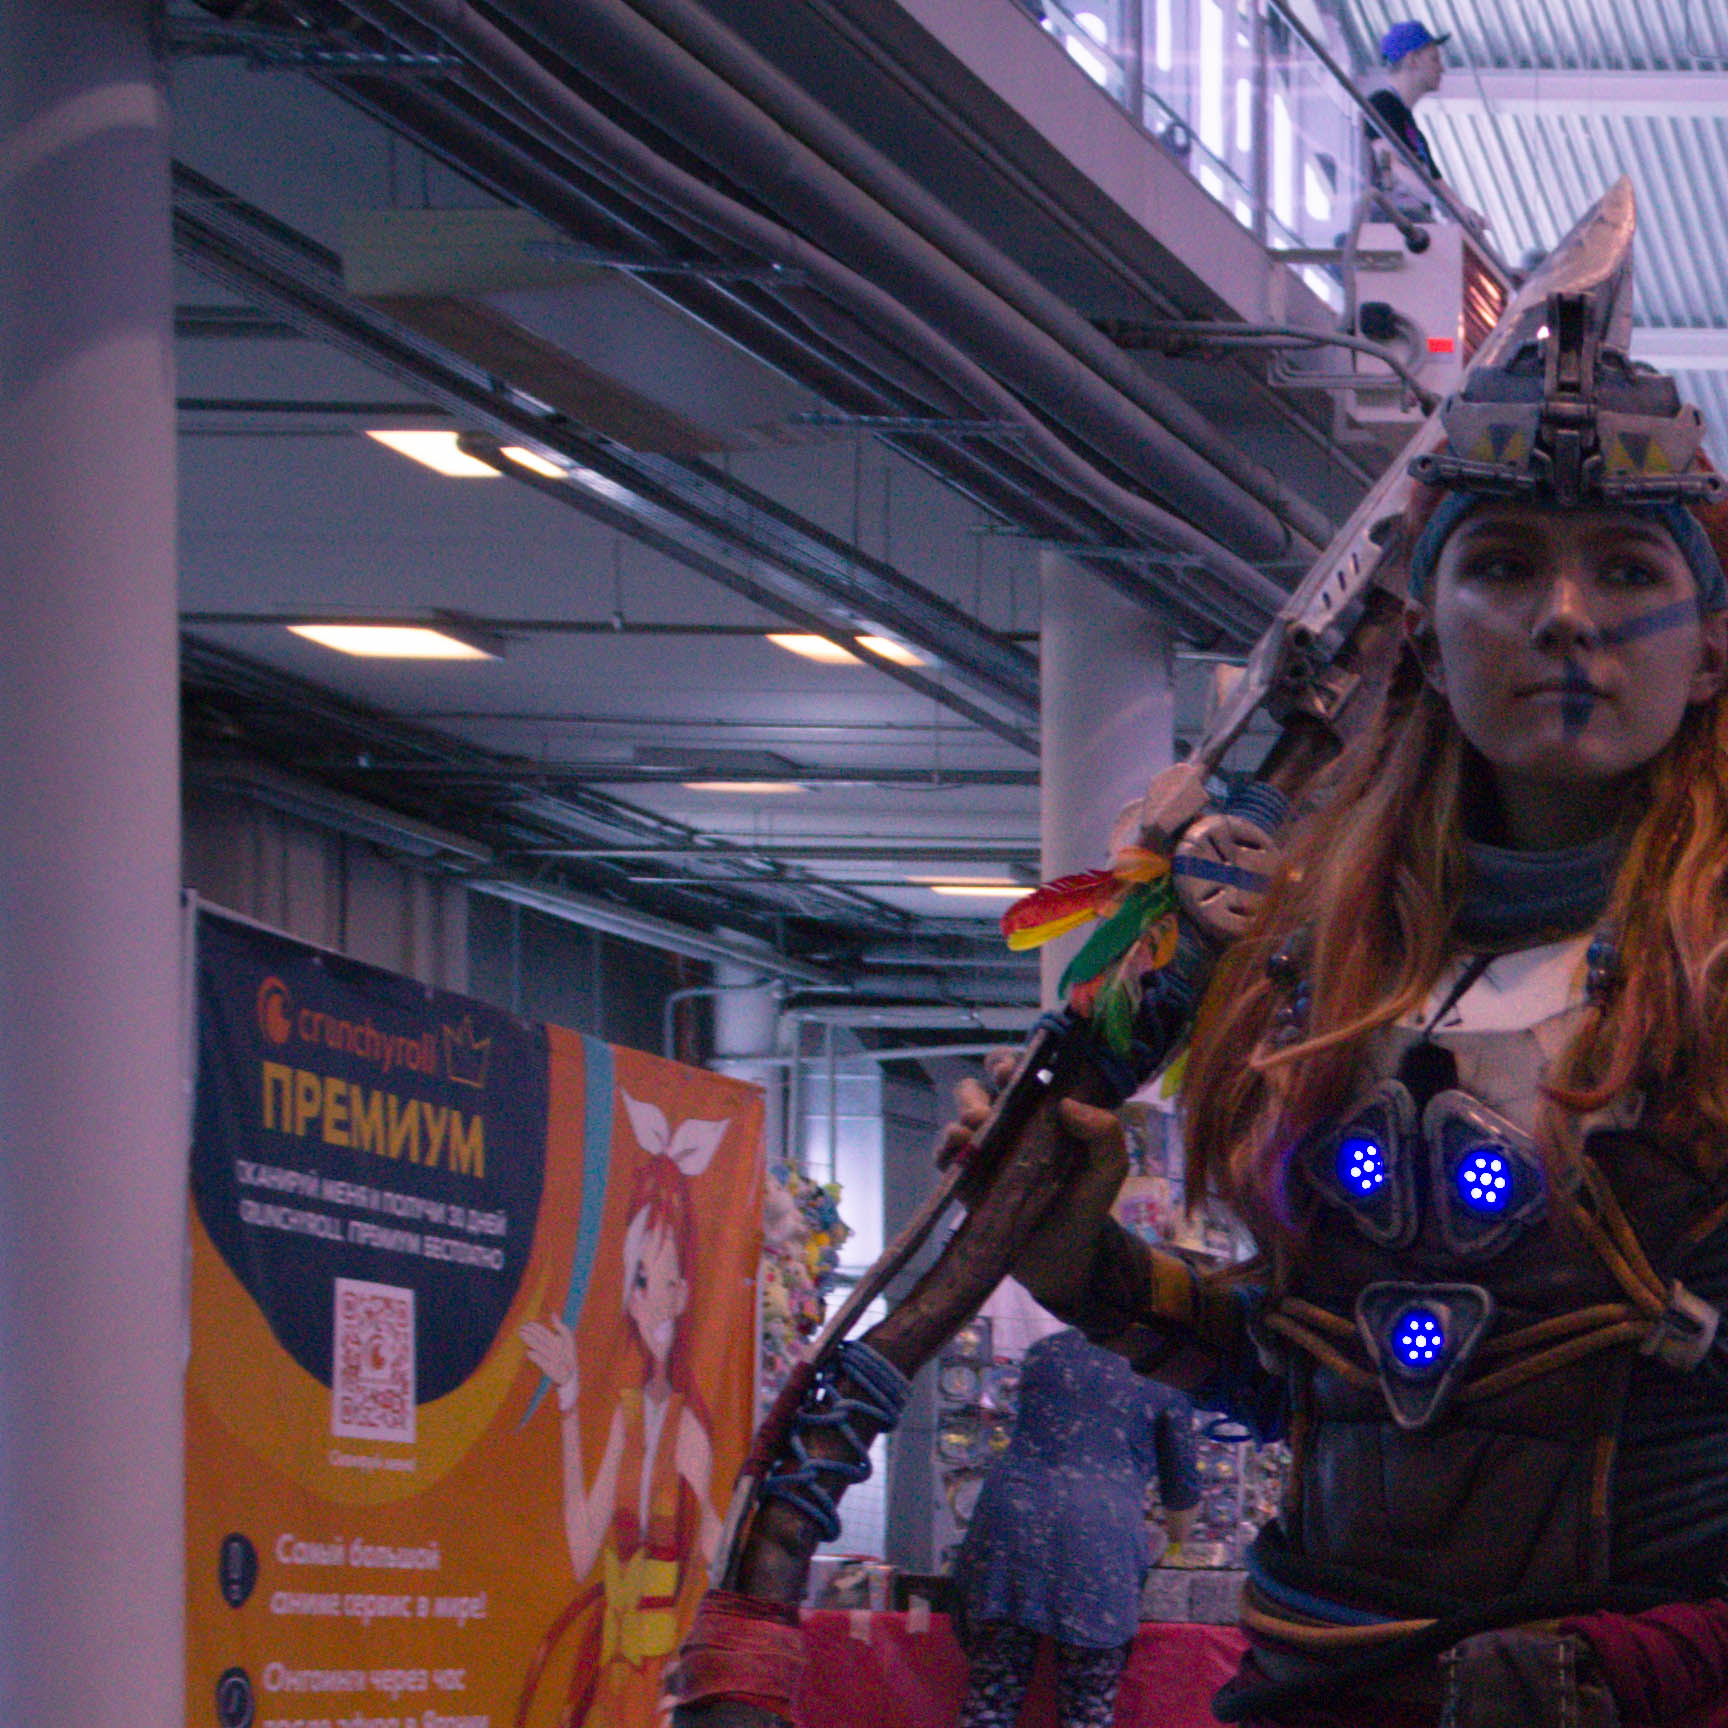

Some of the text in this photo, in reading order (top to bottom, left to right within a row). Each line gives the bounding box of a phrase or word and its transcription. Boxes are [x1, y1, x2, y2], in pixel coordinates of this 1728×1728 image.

[301, 1008, 437, 1074] crunchyroll
[262, 1060, 485, 1178] ПРЕМИУМ
[276, 1533, 441, 1570] Самый большой
[370, 1669, 429, 1700] через
[432, 1669, 466, 1691] час
